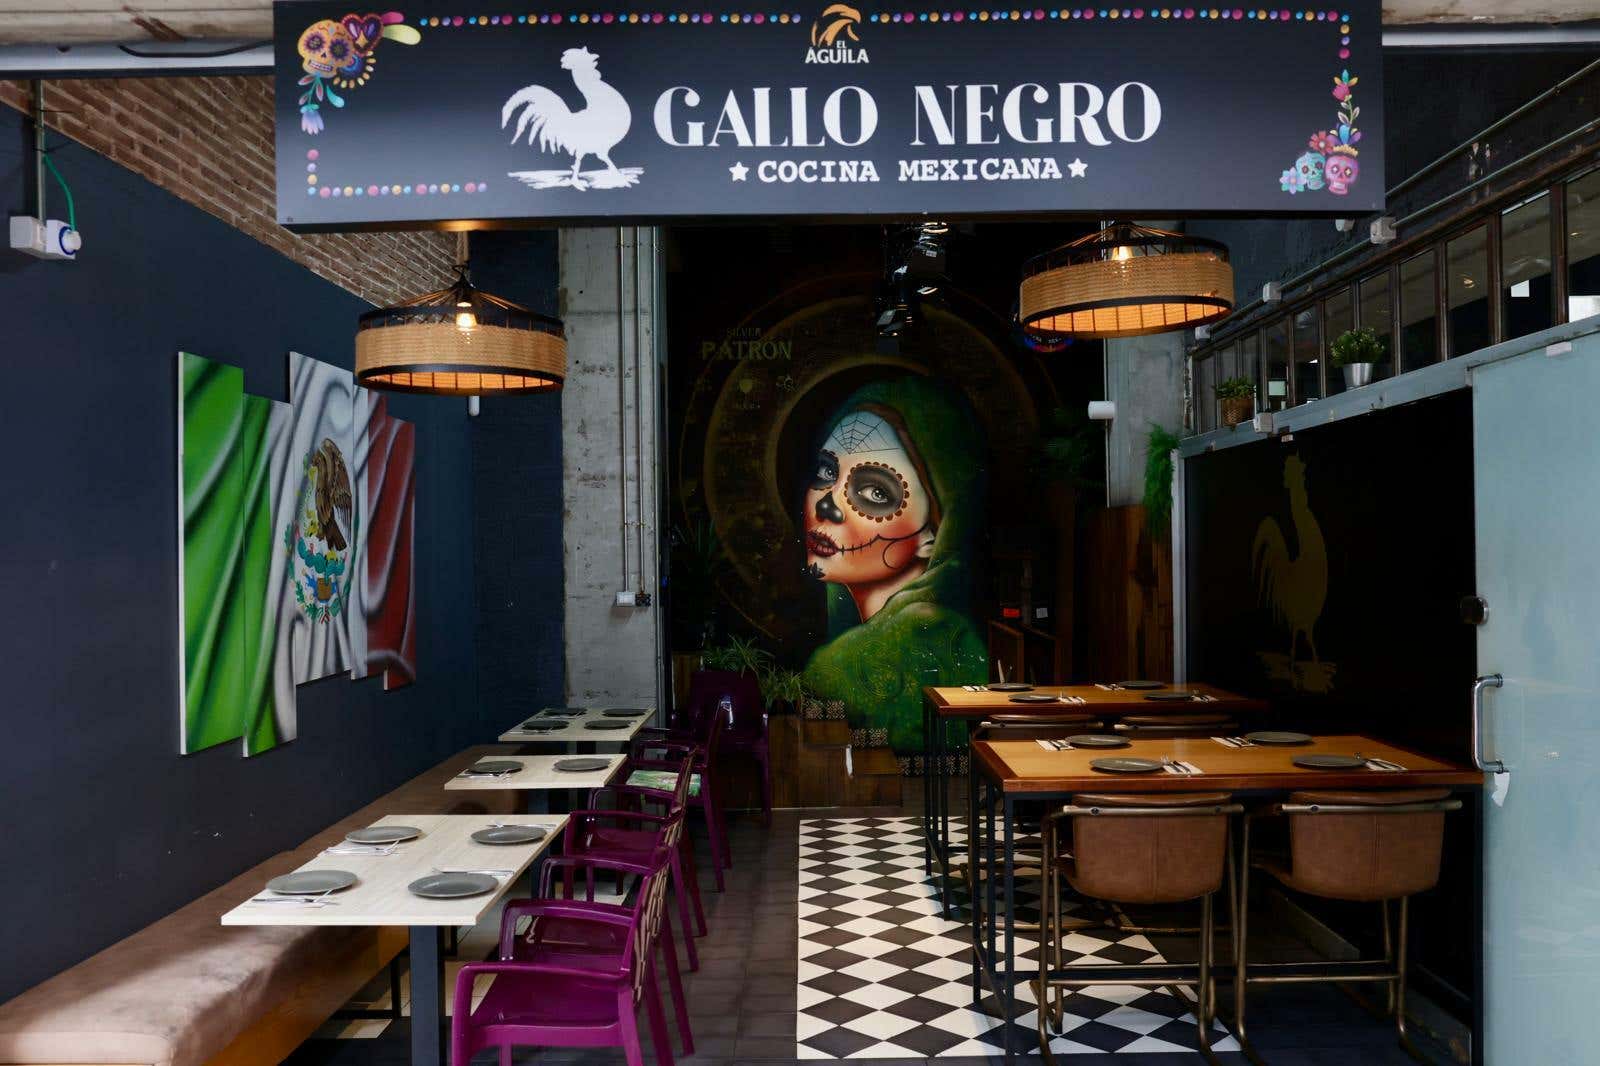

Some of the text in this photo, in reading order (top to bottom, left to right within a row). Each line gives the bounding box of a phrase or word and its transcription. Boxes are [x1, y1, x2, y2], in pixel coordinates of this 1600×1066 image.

[836, 40, 847, 48] EL
[653, 82, 1161, 147] GALLO NEGRO
[758, 157, 1062, 183] COCINA MEXICANA
